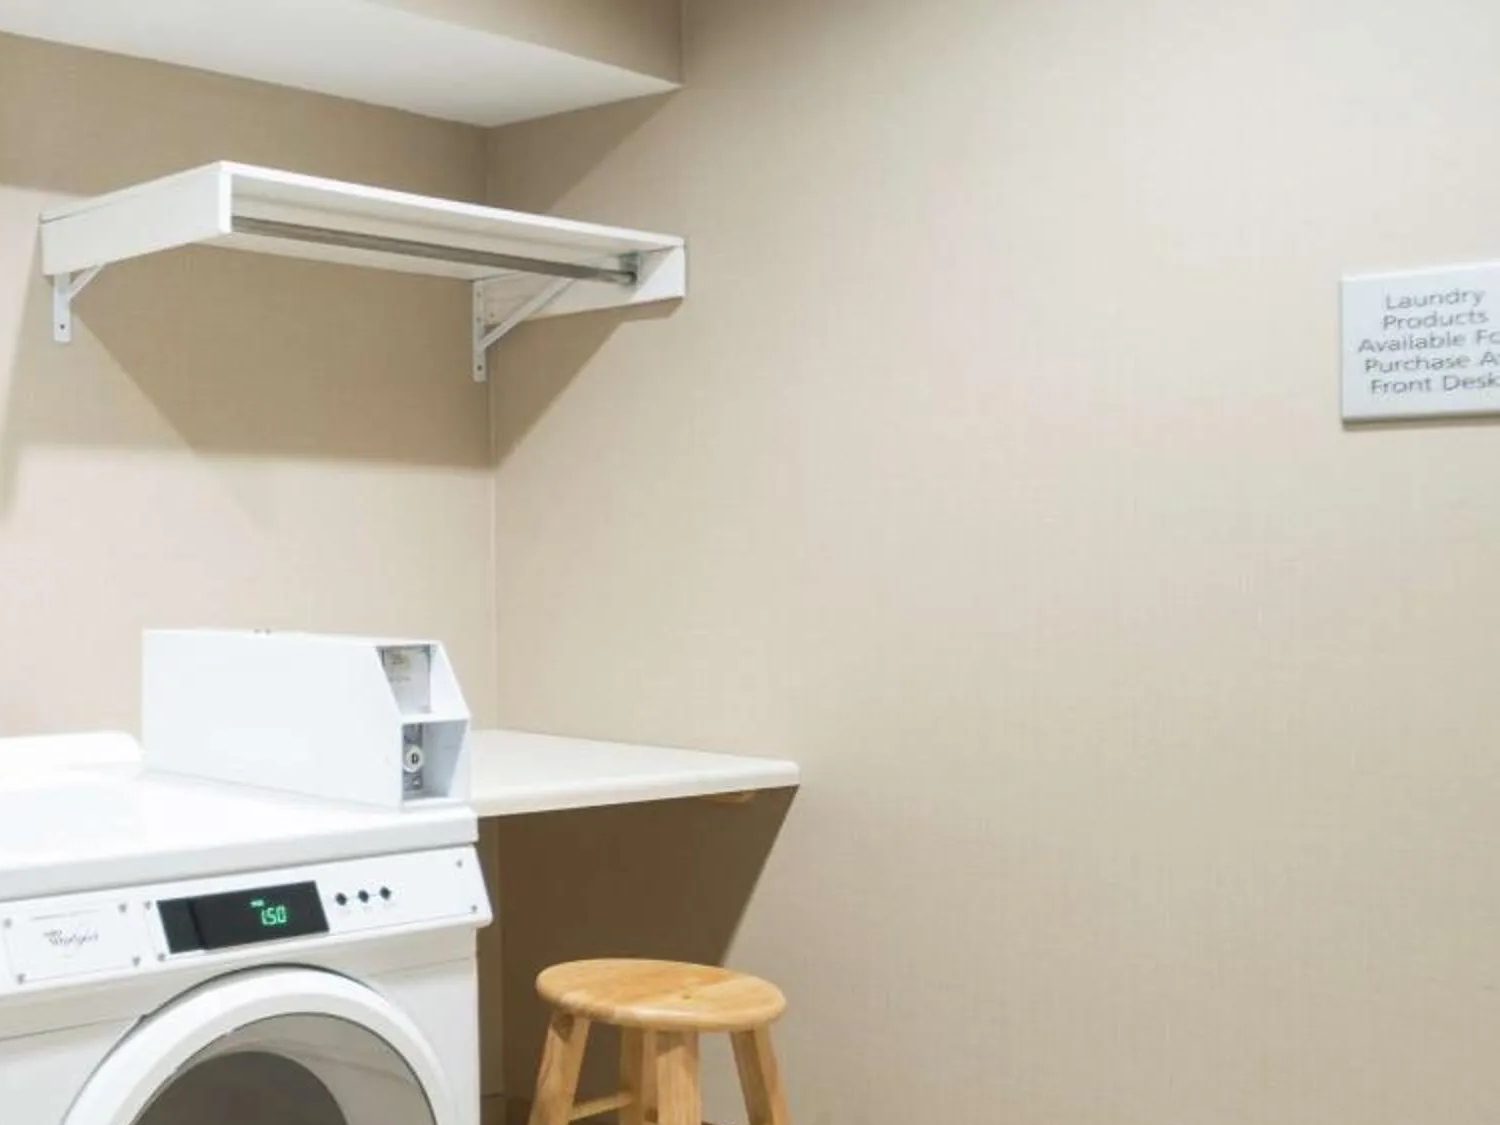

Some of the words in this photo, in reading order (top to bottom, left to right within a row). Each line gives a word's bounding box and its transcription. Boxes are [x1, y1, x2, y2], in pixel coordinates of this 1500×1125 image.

[1385, 288, 1486, 311] Laundry
[1383, 309, 1490, 331] Products
[1358, 331, 1467, 353] Available
[1364, 354, 1471, 374] Purchase
[1479, 351, 1500, 367] A
[1370, 378, 1432, 395] Front
